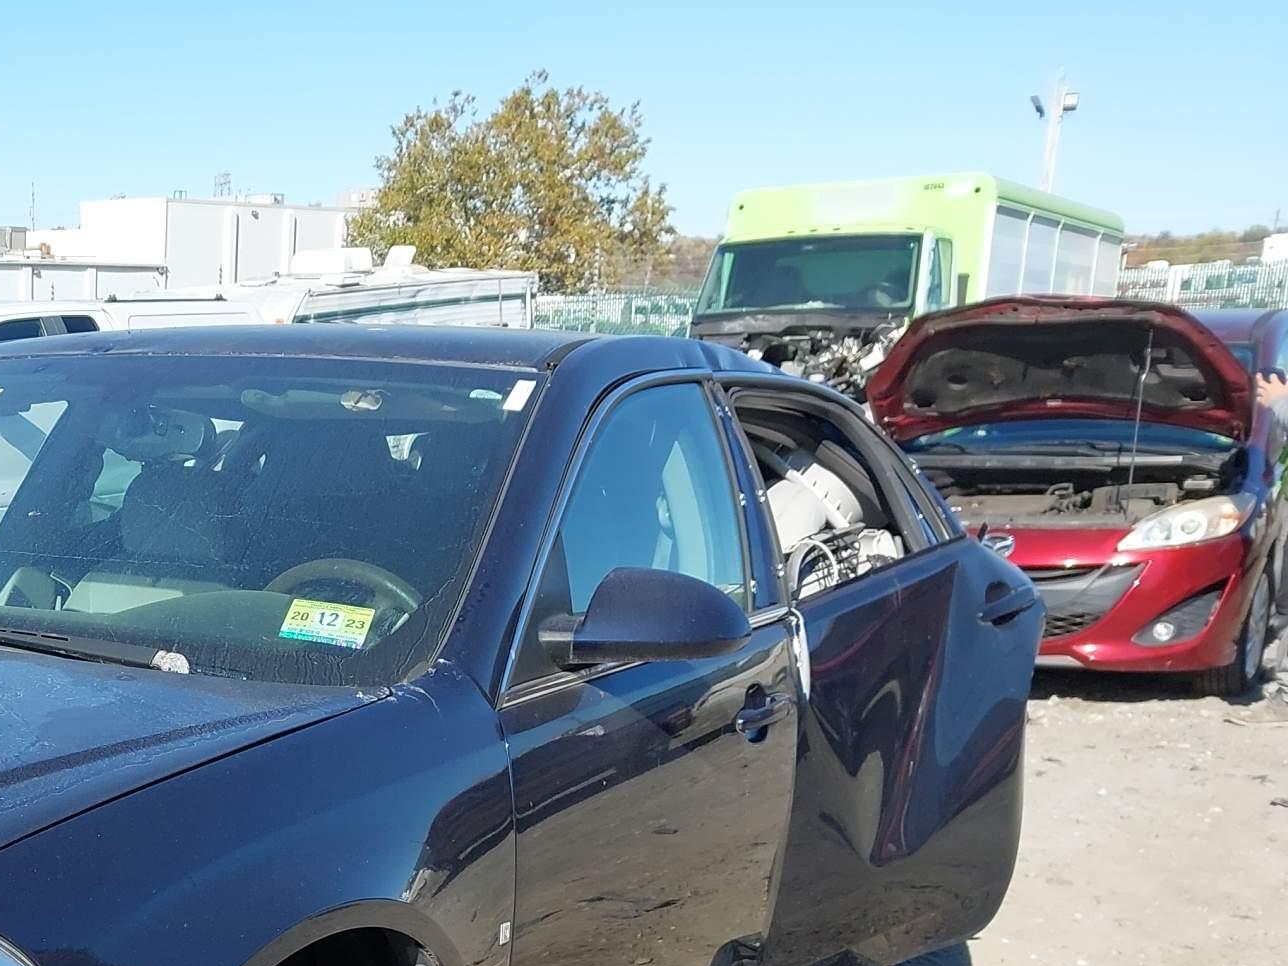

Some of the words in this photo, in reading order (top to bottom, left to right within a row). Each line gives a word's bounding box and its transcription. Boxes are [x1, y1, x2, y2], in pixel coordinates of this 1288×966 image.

[291, 611, 309, 621] 20
[319, 611, 340, 627] 12
[345, 619, 365, 629] 23
